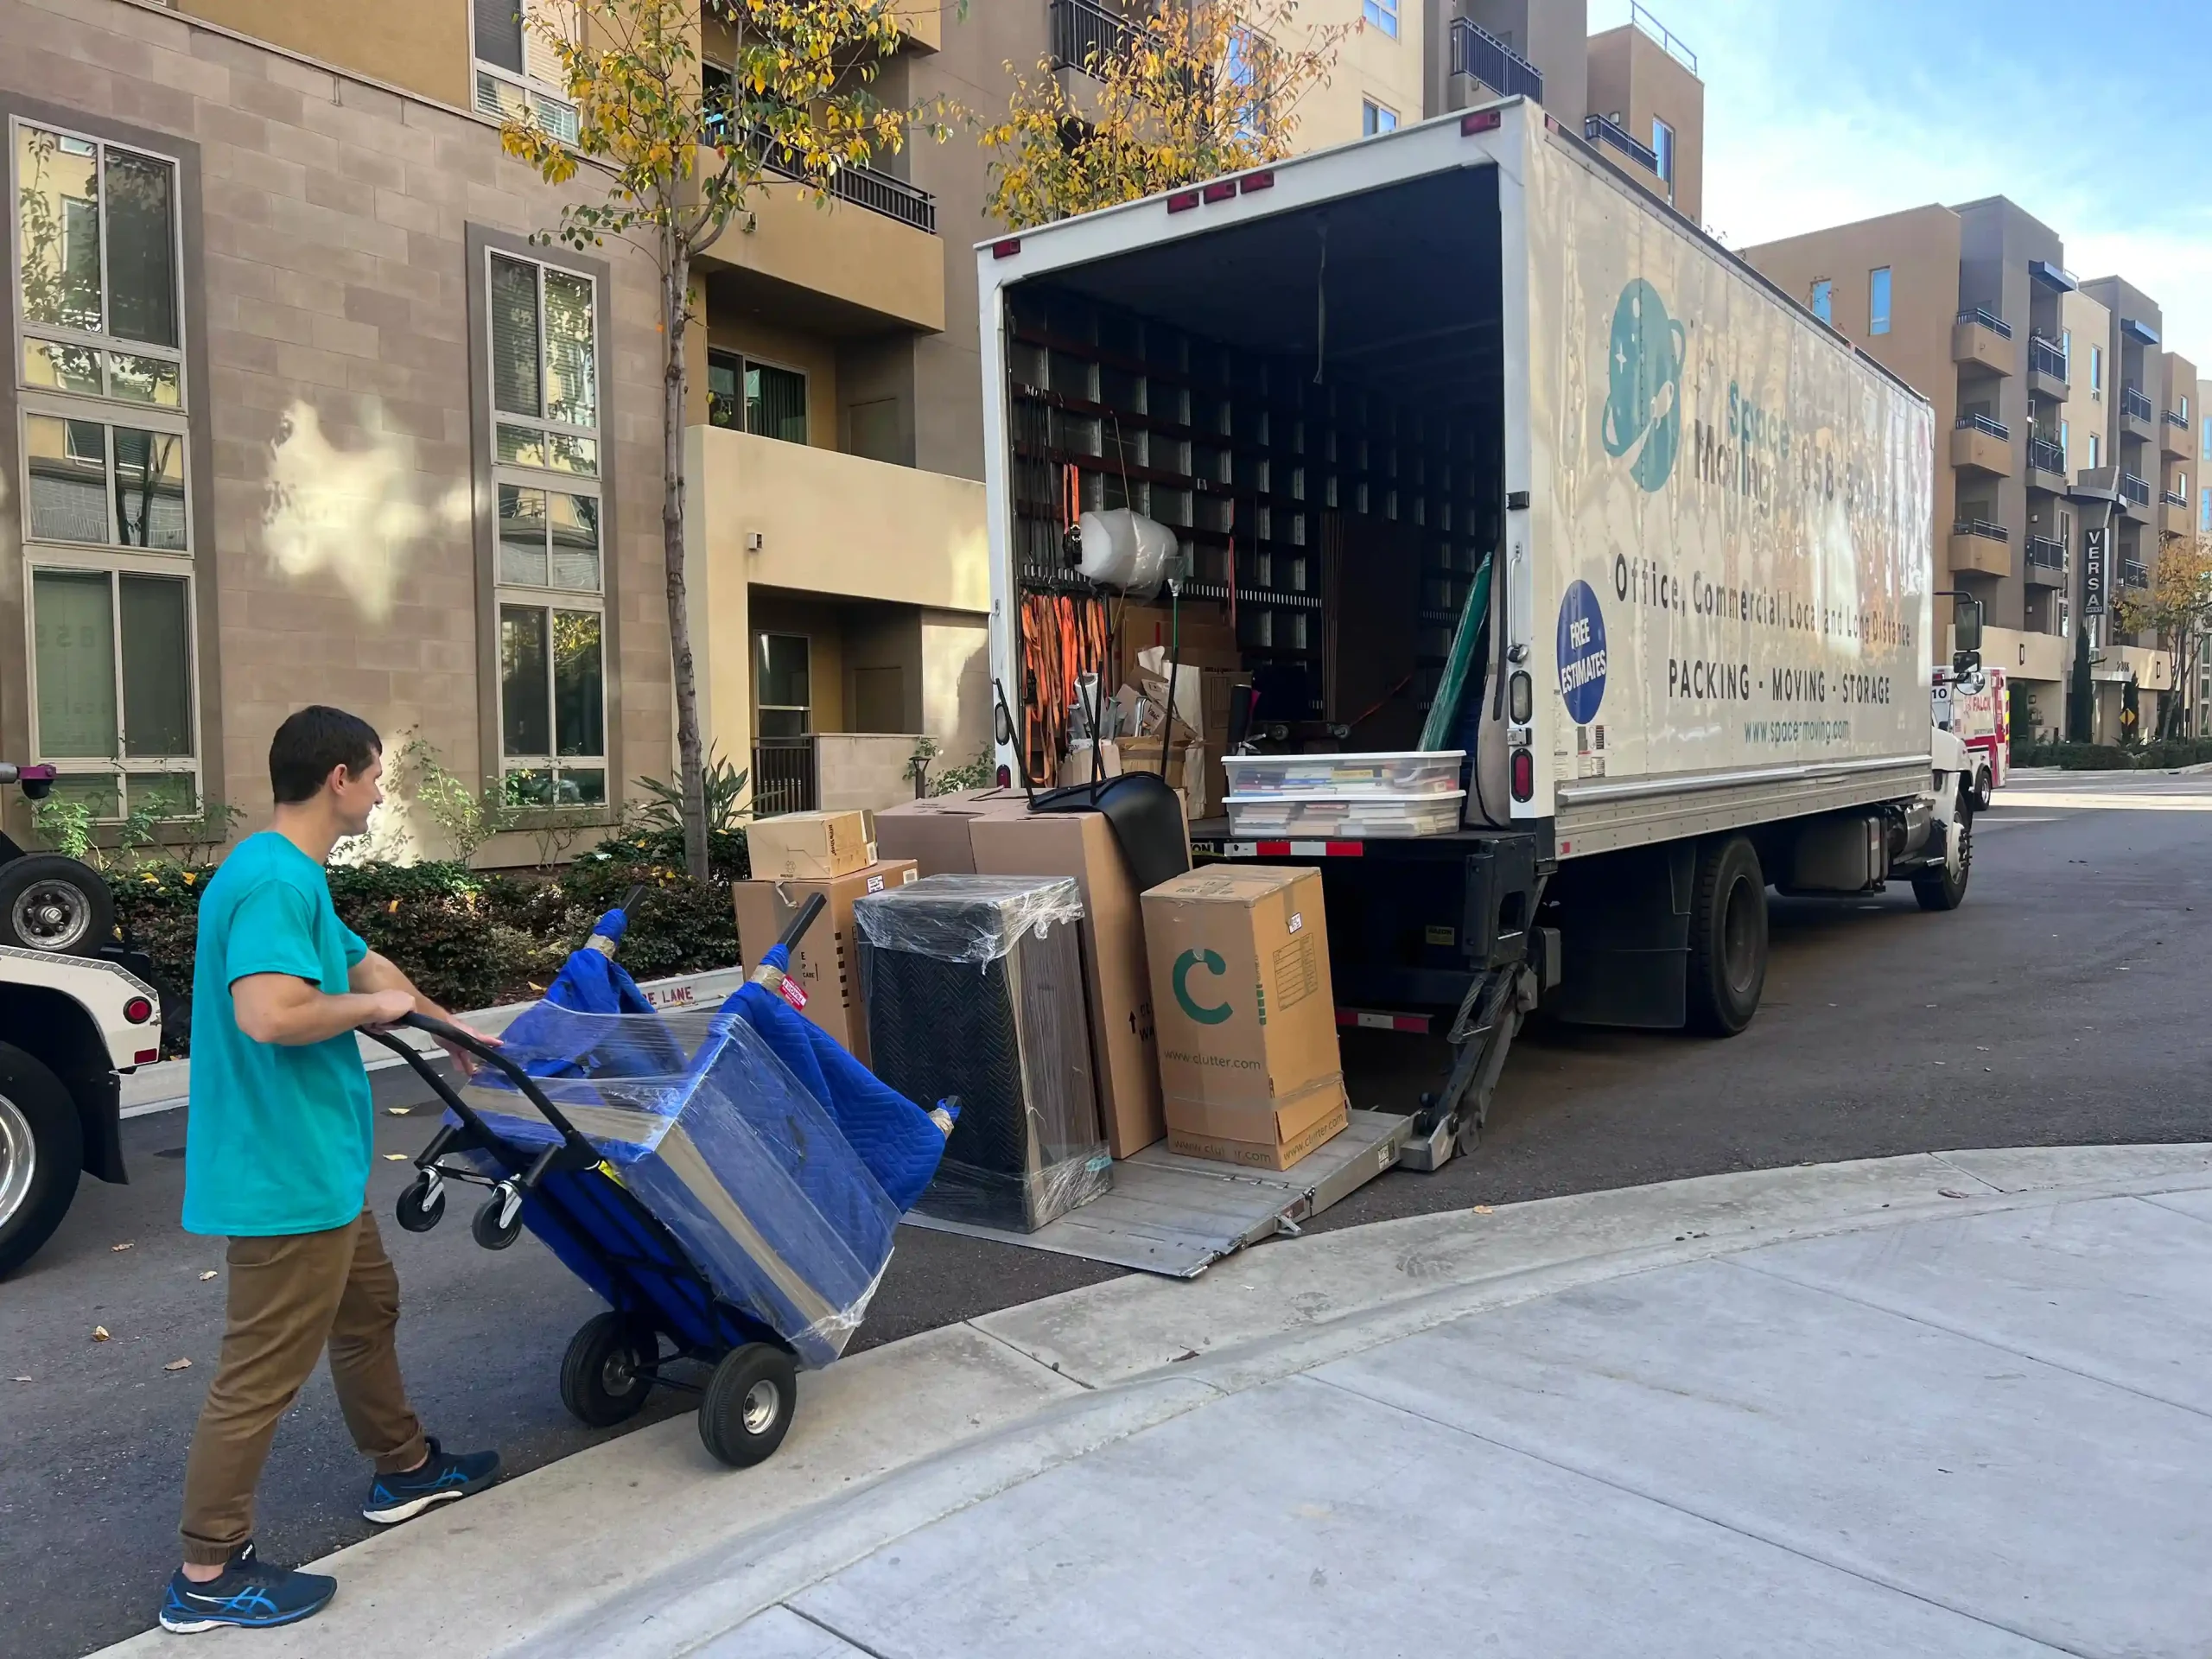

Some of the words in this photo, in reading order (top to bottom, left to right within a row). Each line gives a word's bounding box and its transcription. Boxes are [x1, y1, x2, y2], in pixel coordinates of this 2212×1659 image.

[1730, 379, 1789, 460] Space
[1694, 419, 1771, 518] Moving
[2087, 531, 2101, 607] VERSA
[1616, 552, 1685, 617] Office,
[1694, 570, 1785, 631] Commercial,
[1789, 592, 1820, 633] Local
[1825, 603, 1842, 636] and
[1847, 605, 1870, 644] Long
[1872, 611, 1910, 647] Distance
[1570, 617, 1590, 649] FREE
[1561, 649, 1606, 694] ESTIMATES
[1669, 658, 1750, 701] PACKING
[1772, 667, 1825, 702] MOVING
[1843, 673, 1890, 704] STORAGE
[1744, 718, 1849, 747] www.space-moving.com
[662, 986, 694, 1003] LANE
[784, 981, 804, 1002] FRAGILE
[1164, 1049, 1261, 1071] www.clutter.com
